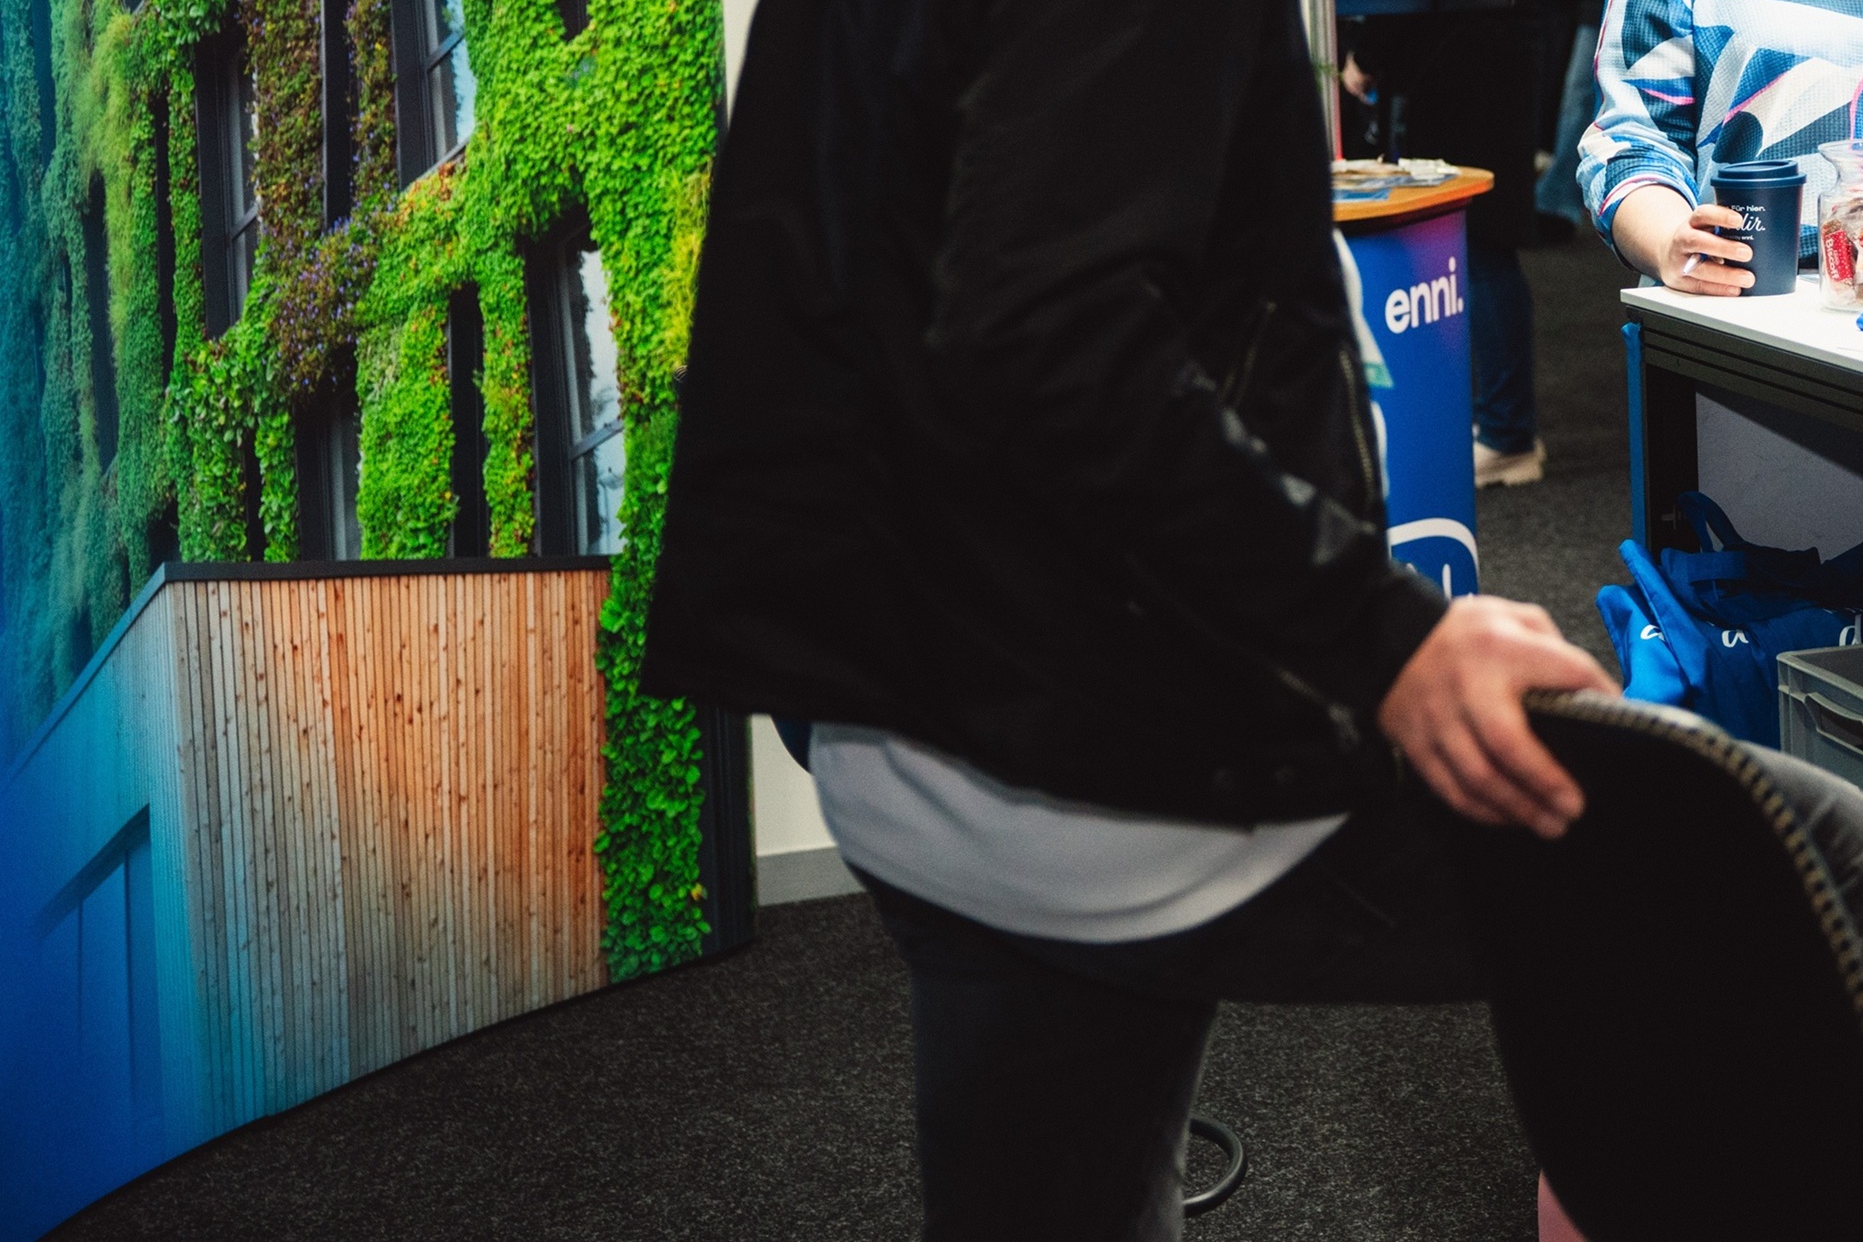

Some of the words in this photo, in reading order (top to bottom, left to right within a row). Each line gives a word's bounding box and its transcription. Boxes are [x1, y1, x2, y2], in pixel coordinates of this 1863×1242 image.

[1746, 204, 1766, 212] hier.
[1825, 238, 1839, 281] Biscoff
[1385, 256, 1464, 334] enni.
